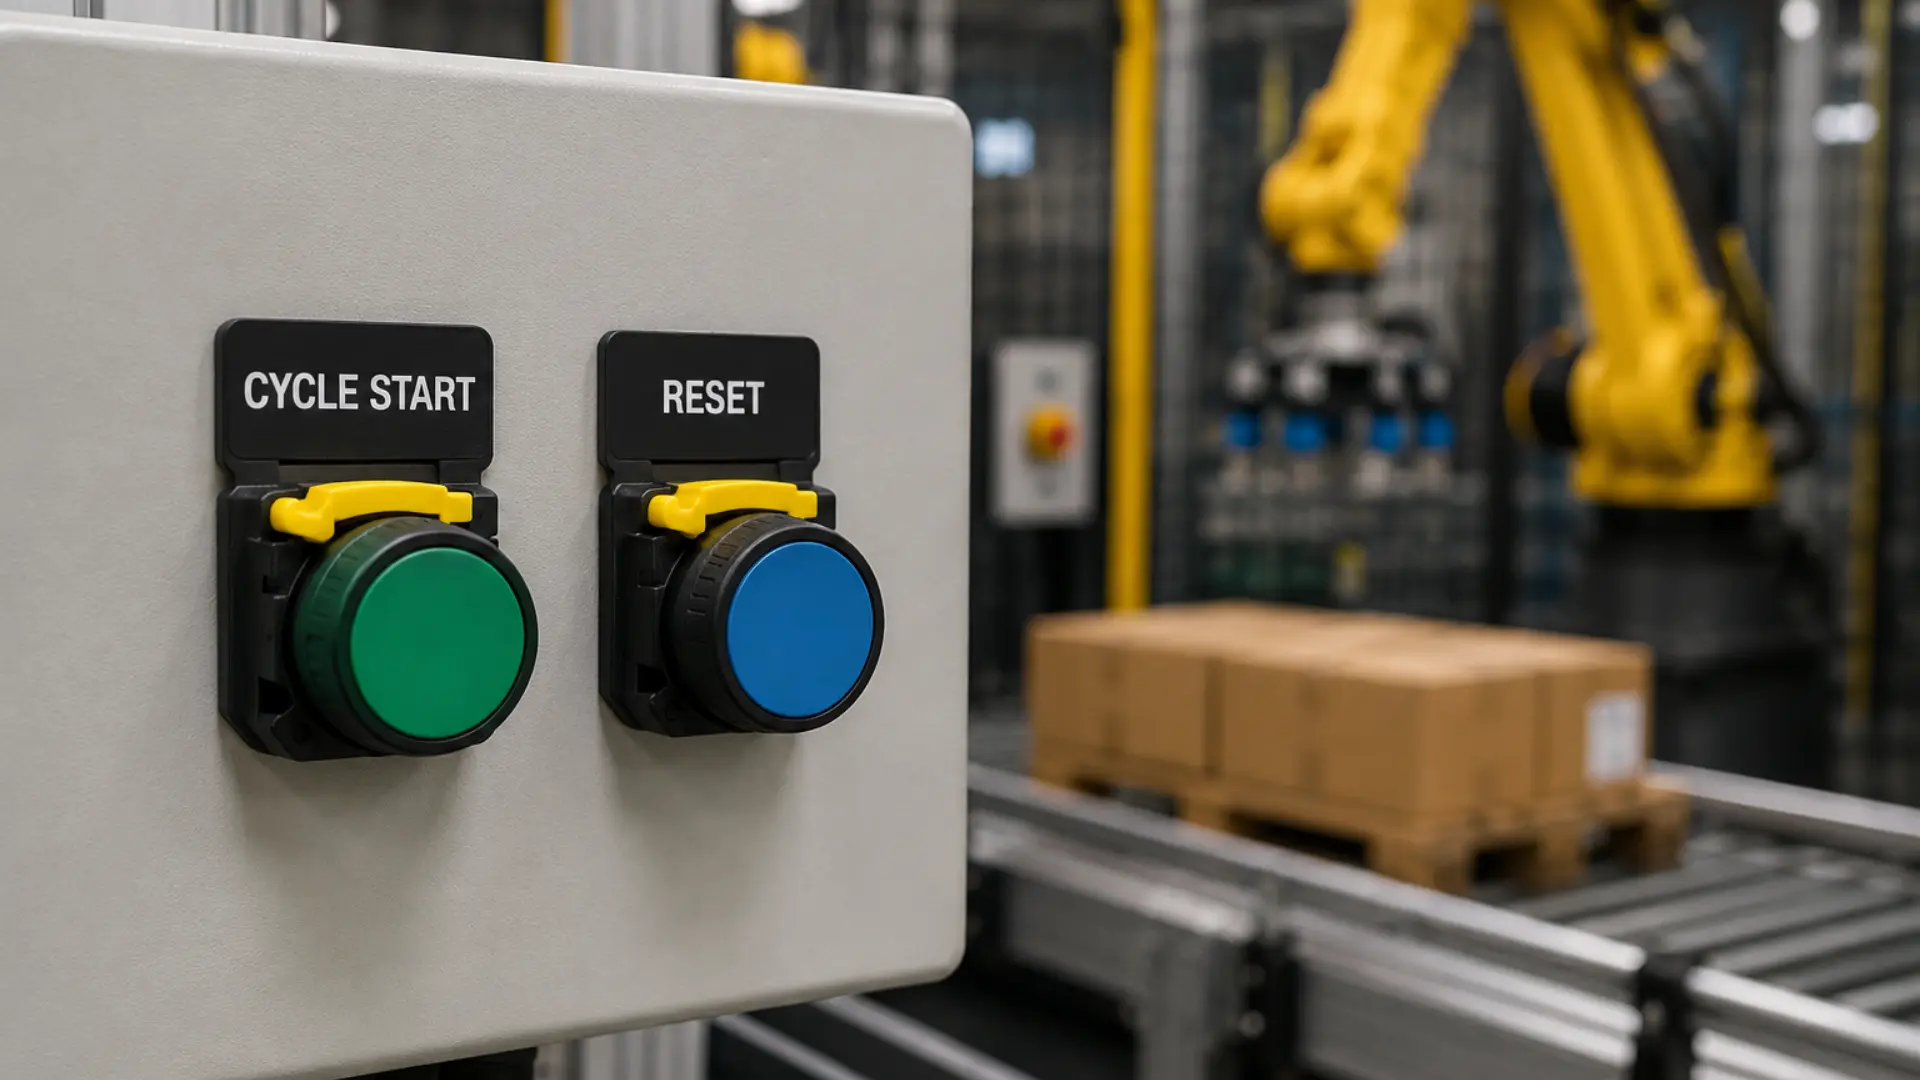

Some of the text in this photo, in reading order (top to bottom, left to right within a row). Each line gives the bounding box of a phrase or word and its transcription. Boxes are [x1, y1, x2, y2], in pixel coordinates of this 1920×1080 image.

[244, 371, 476, 412] CYCLE START
[663, 379, 765, 414] RESET
